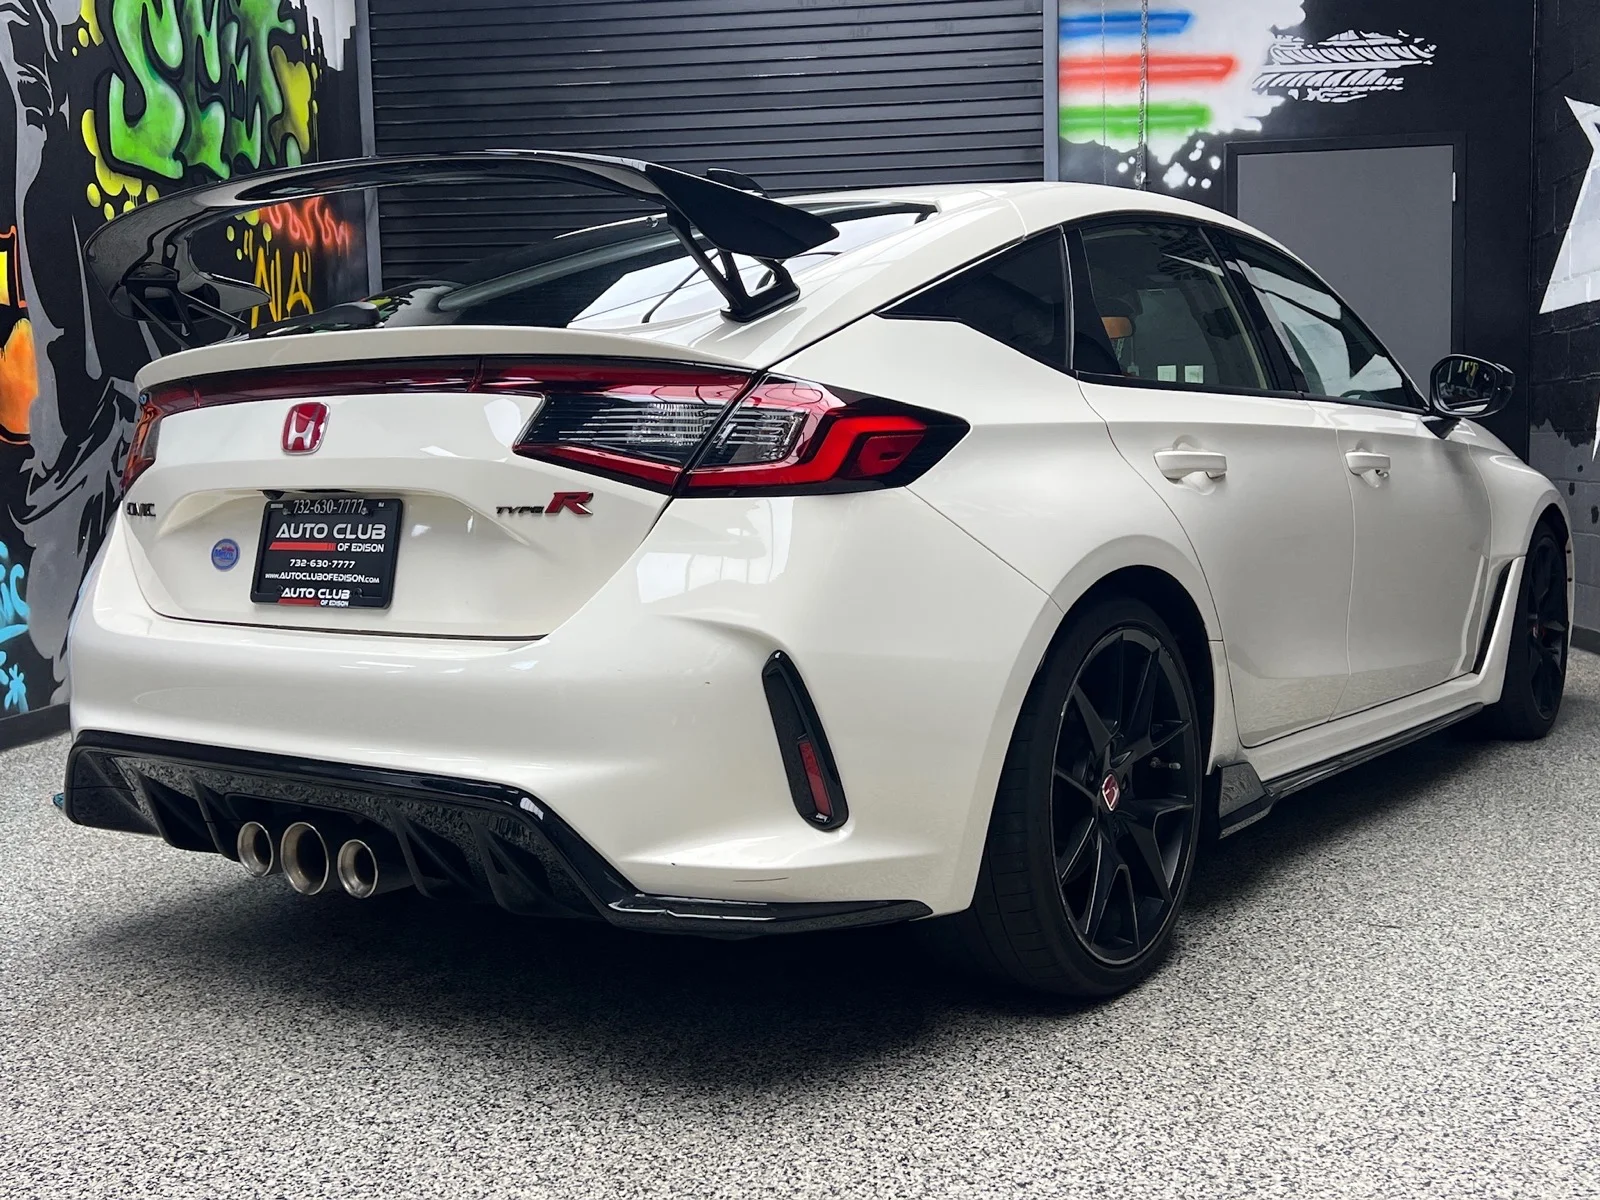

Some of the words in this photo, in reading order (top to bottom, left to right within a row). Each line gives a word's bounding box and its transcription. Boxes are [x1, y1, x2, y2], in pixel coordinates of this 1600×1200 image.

[293, 499, 364, 514] 732-630-7777
[496, 506, 544, 515] TYPE
[544, 491, 594, 515] R
[275, 523, 328, 539] AUTO
[332, 523, 387, 540] CLUB
[337, 542, 350, 552] OF
[351, 543, 385, 553] EDISON
[289, 558, 356, 569] 732-630-7777
[281, 587, 315, 598] AUTO
[317, 588, 351, 600] CLUB
